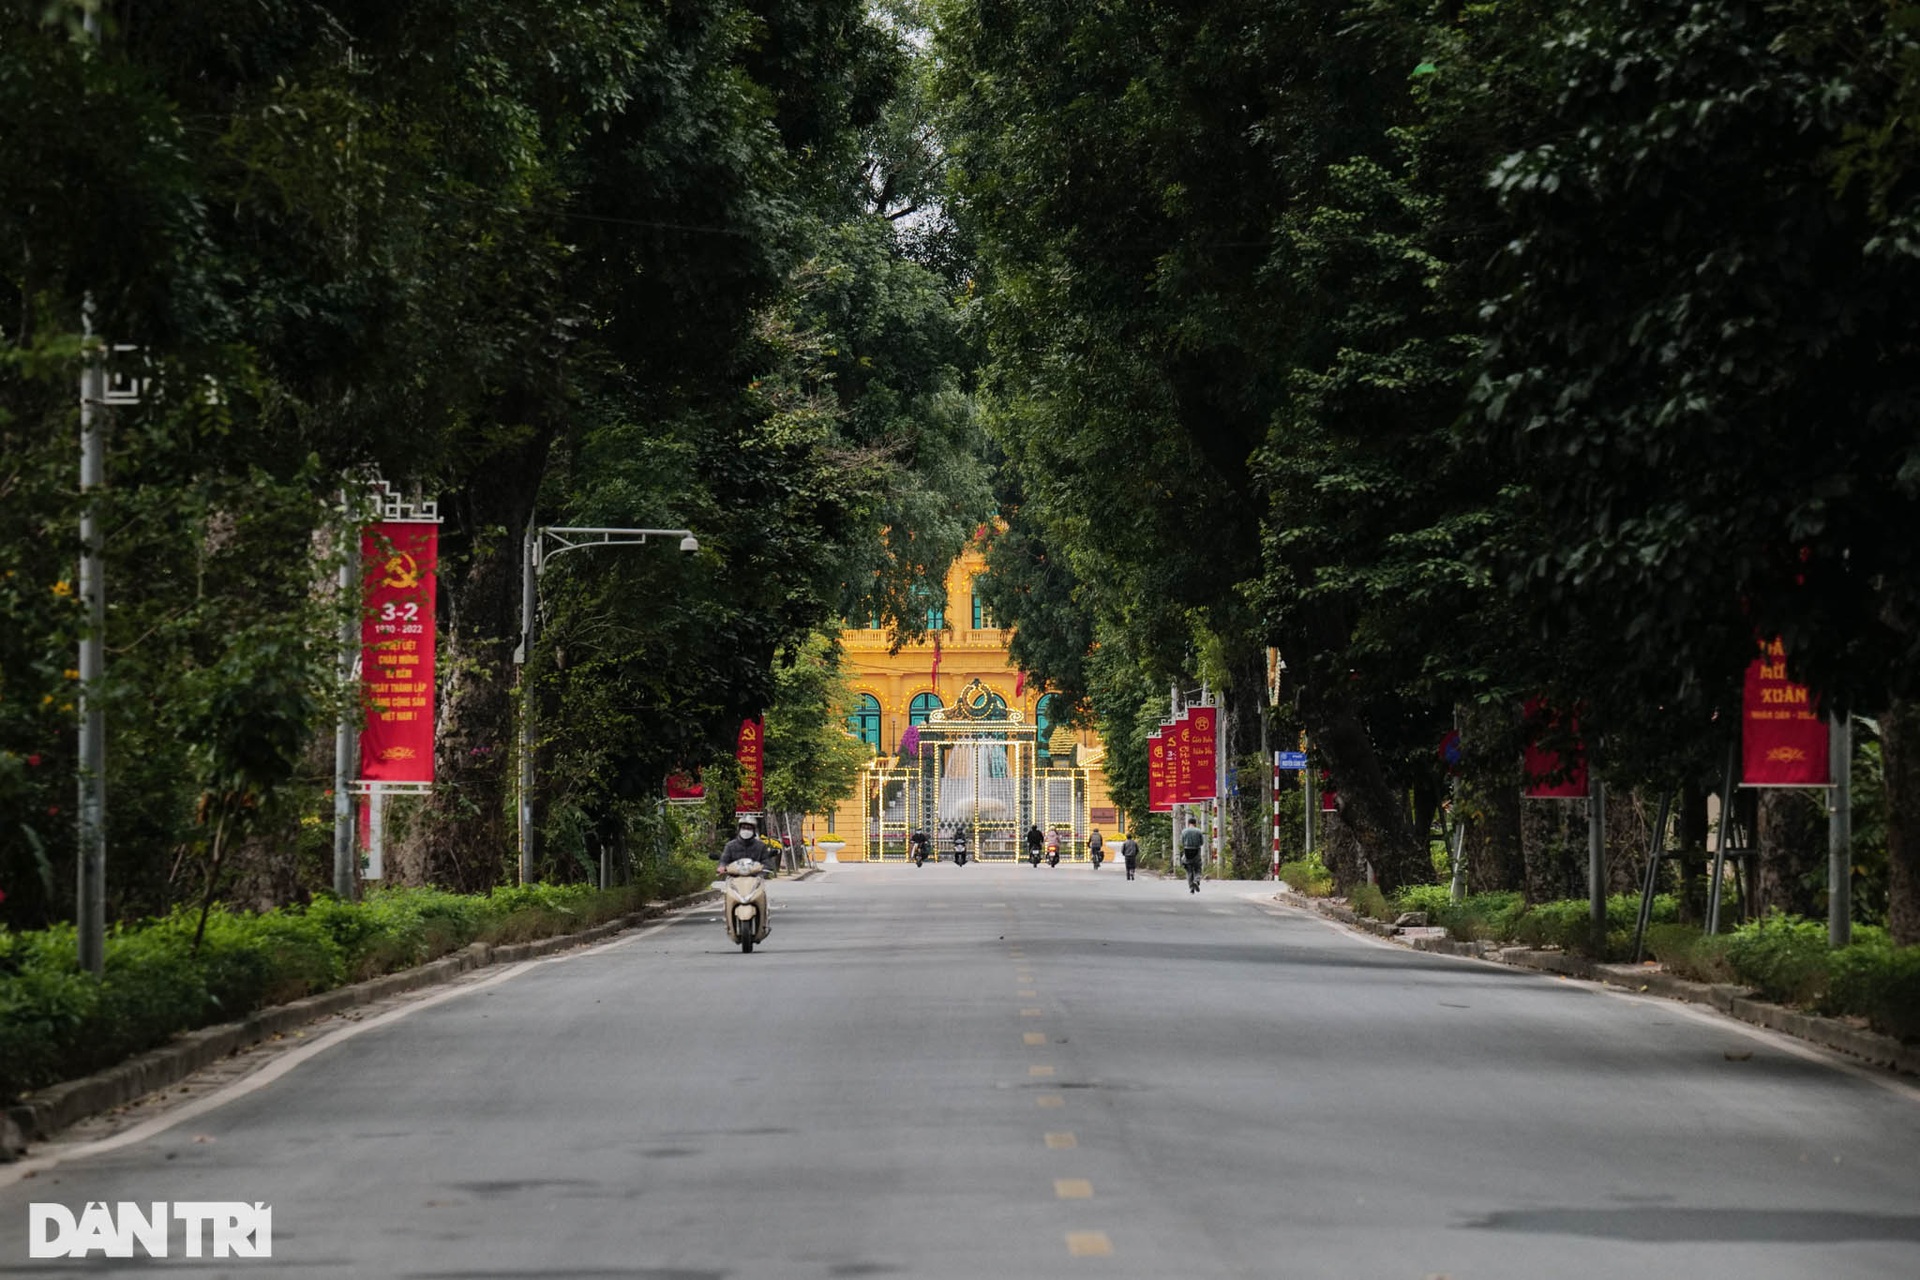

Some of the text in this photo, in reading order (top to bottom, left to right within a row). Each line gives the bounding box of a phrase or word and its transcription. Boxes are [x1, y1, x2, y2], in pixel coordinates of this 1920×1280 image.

[381, 602, 418, 621] 3-2
[402, 624, 423, 634] 2022
[1761, 685, 1808, 703] XUÂN
